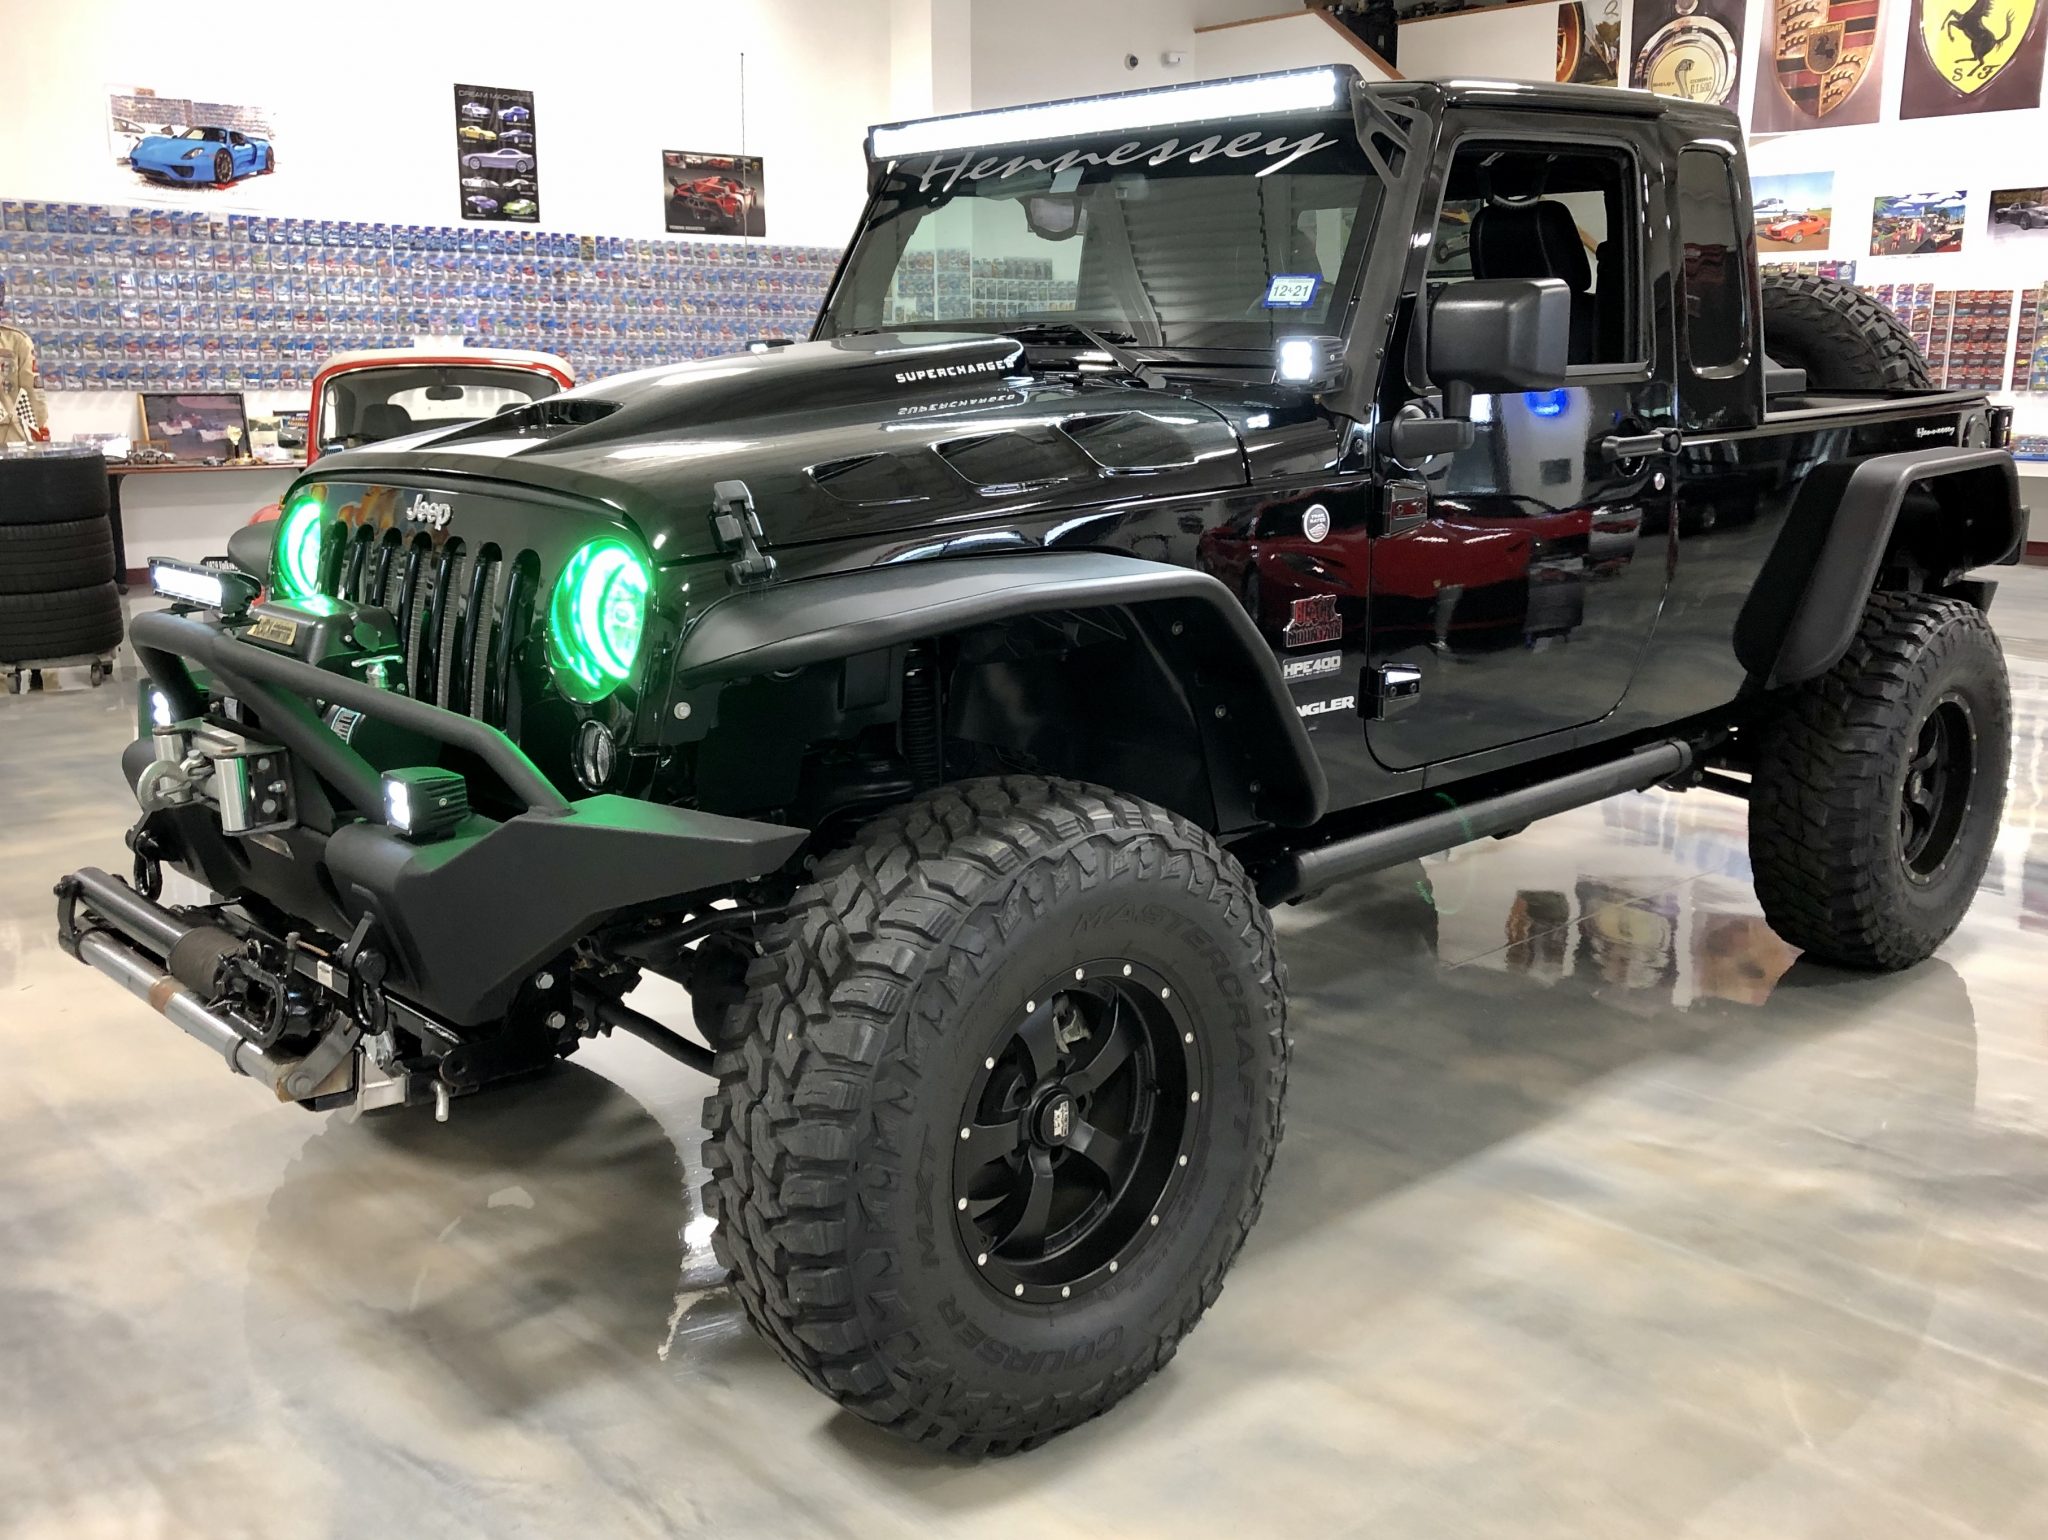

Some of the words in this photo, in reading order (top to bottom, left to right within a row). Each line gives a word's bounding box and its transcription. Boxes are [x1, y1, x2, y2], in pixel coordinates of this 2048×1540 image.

[1951, 67, 1964, 82] S
[1977, 64, 2001, 80] F
[918, 132, 1338, 193] Hennessey
[1273, 285, 1289, 297] 12
[1292, 285, 1309, 297] 21
[406, 493, 452, 531] Jeep
[1283, 655, 1341, 677] HPE400
